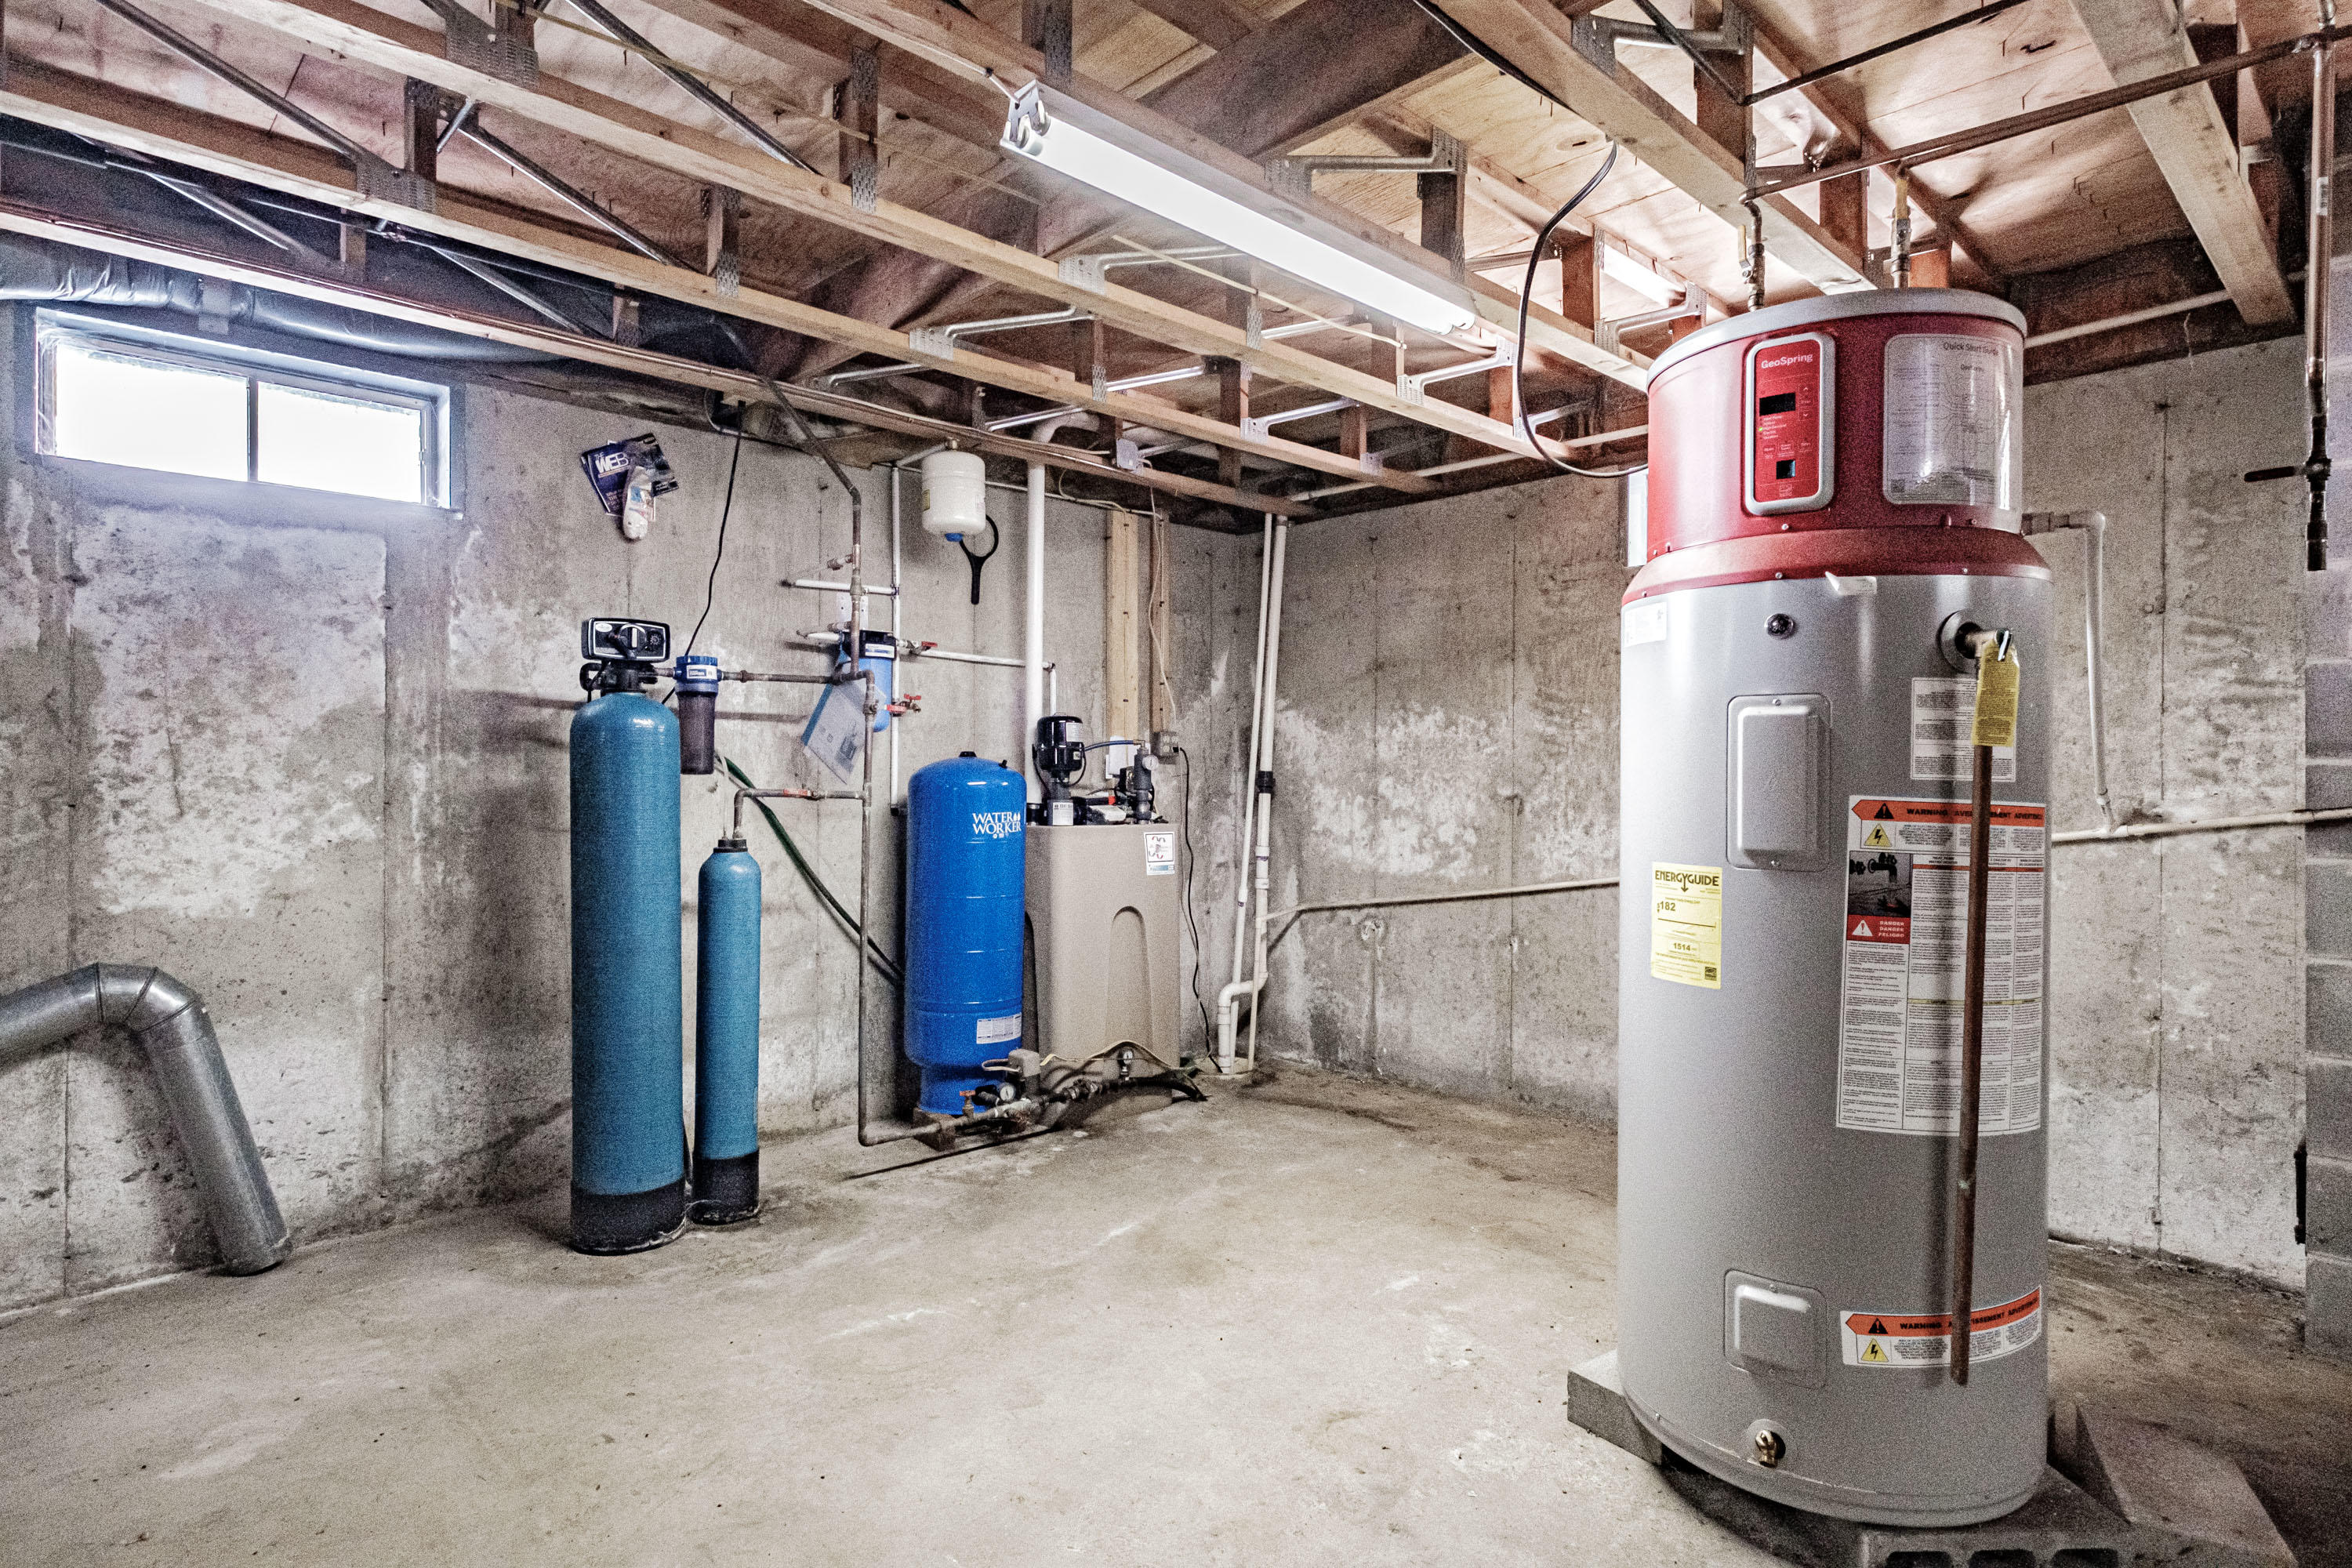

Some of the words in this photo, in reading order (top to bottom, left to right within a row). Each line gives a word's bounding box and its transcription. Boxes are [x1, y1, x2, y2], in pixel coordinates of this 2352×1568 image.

[1761, 354, 1813, 369] GeoSpring
[595, 452, 629, 474] WEB
[972, 811, 1014, 824] WATER
[1907, 808, 1948, 817] WARNING
[972, 822, 1022, 834] WORKER
[1655, 870, 1719, 887] ENERGYGUIDE
[1673, 942, 1690, 951] 1514
[1900, 1322, 1942, 1330] WARNING
